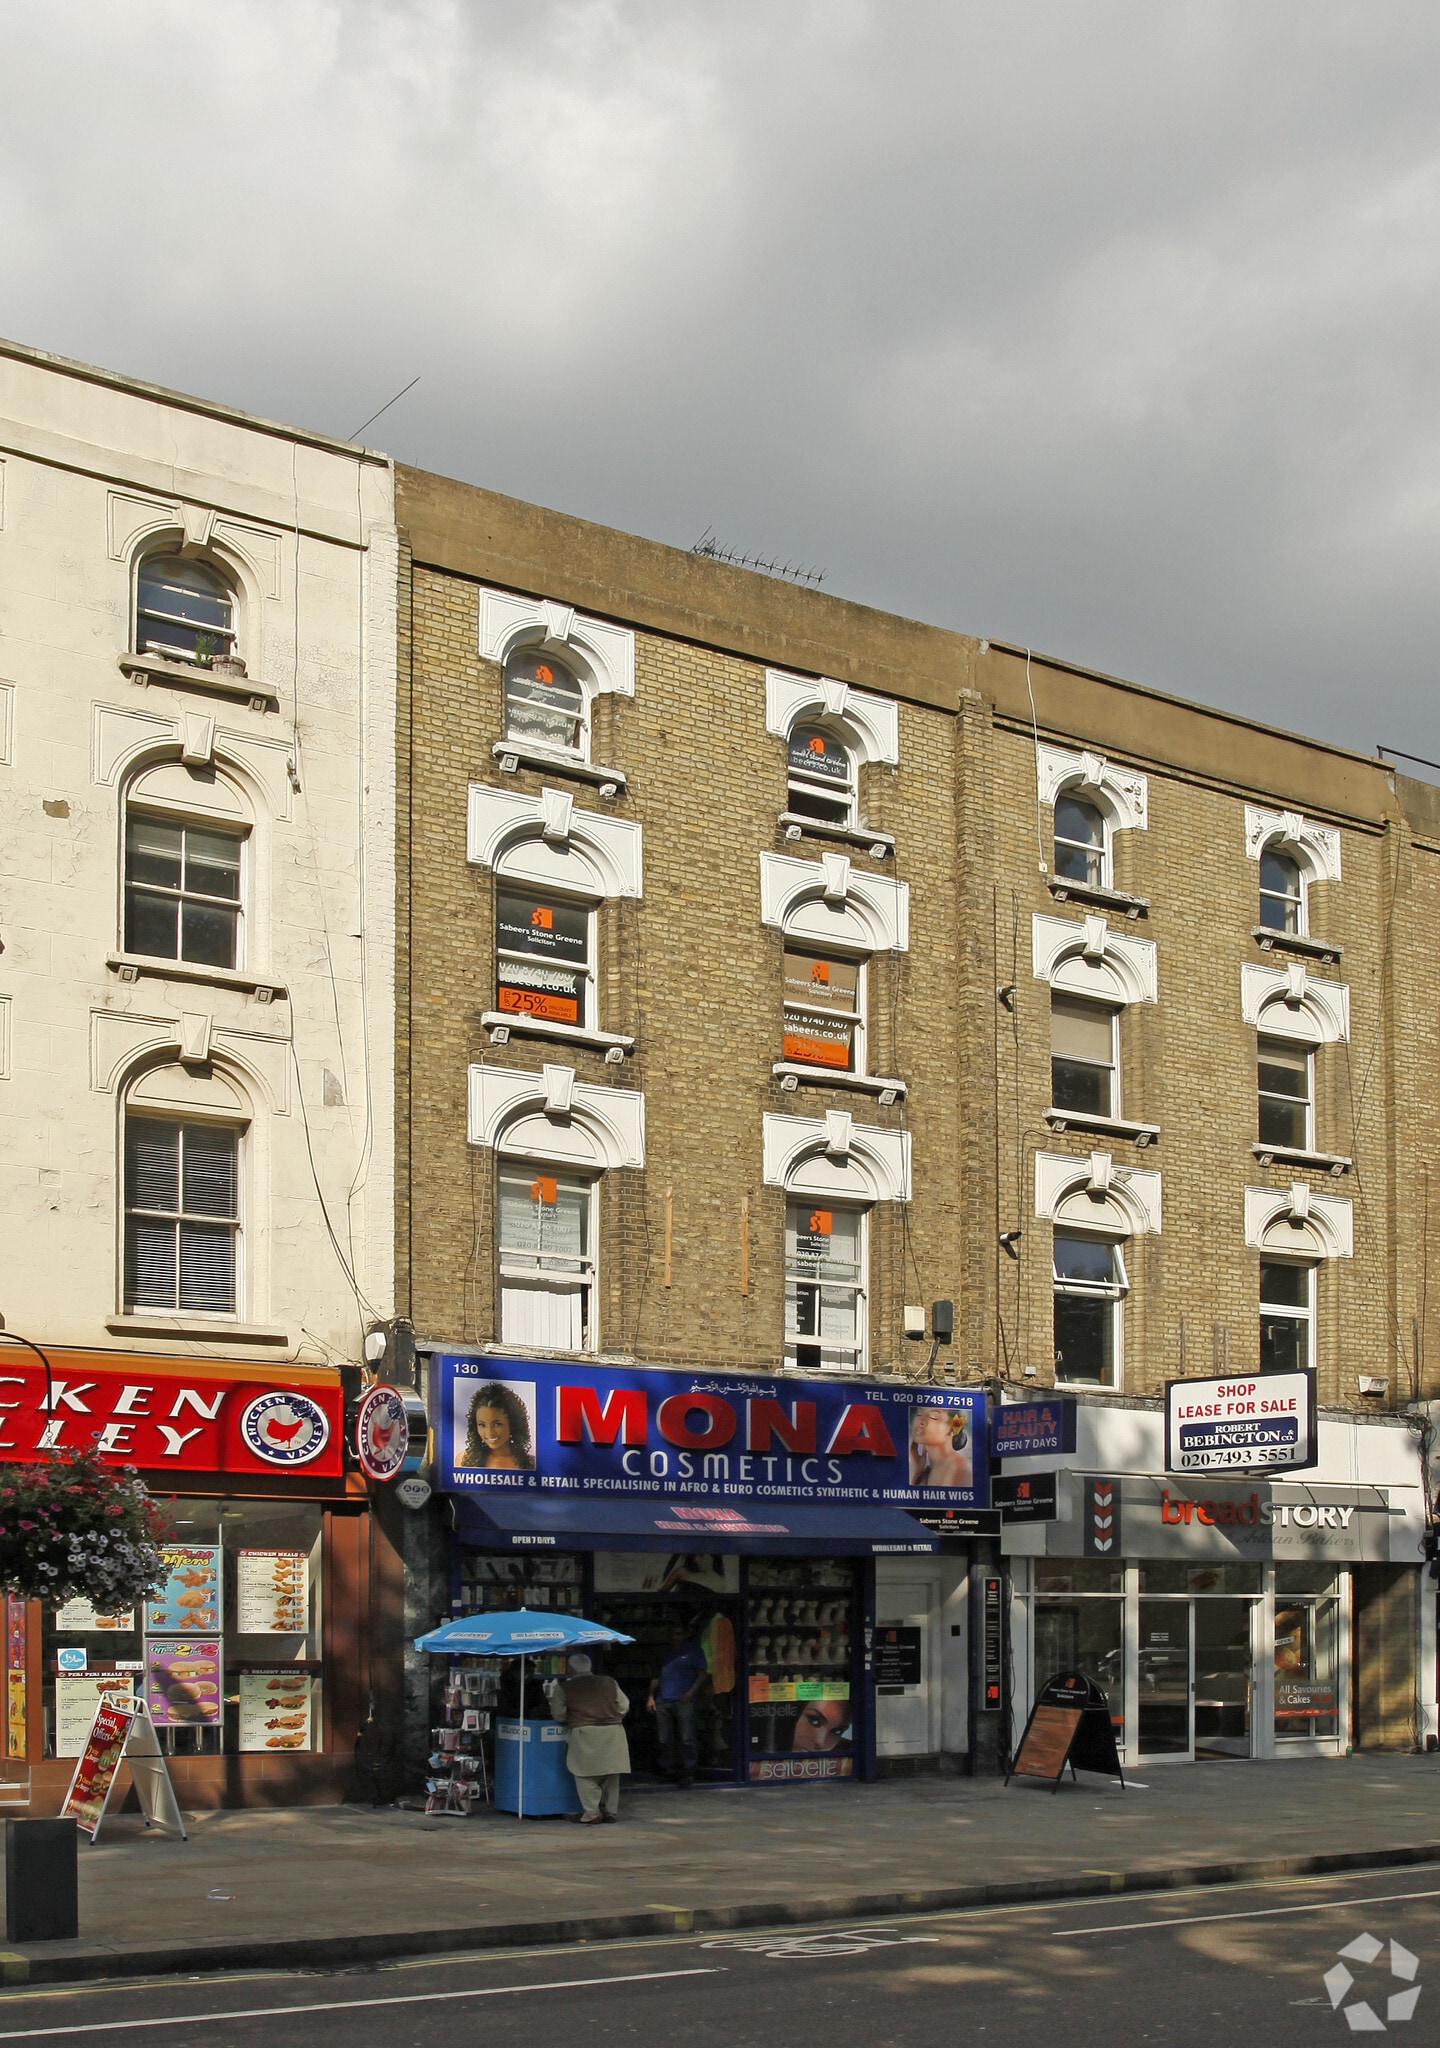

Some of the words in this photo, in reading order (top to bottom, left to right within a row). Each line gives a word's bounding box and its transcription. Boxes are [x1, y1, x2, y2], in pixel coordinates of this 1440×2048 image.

[499, 922, 530, 935] Sabeers
[531, 929, 553, 940] Stone
[555, 933, 583, 945] Greene
[527, 935, 556, 946] Solicitors
[784, 976, 811, 987] Sabeers
[811, 981, 831, 991] Stone
[831, 985, 856, 996] Greene
[511, 991, 548, 1014] 25%
[783, 1023, 849, 1041] sabeers.co.uk
[454, 1363, 478, 1374] 130
[865, 1391, 889, 1401] TEL.
[893, 1393, 914, 1403] 020
[916, 1394, 944, 1405] 8749
[947, 1396, 974, 1406] 7518
[1217, 1383, 1256, 1398] SHOP
[1003, 1408, 1037, 1425] HAIR
[1041, 1407, 1052, 1420] &
[1178, 1404, 1222, 1419] LEASE
[1227, 1402, 1256, 1416] FOR
[1260, 1398, 1297, 1413] SALE
[248, 1396, 287, 1447] CHICKEN
[361, 1393, 386, 1456] CHICKEN
[556, 1385, 898, 1457] MONA
[1215, 1422, 1261, 1433] ROBERT
[998, 1421, 1057, 1439] BEAUTY
[286, 1421, 322, 1459] VALLEY
[996, 1440, 1022, 1452] OPEN
[1025, 1439, 1031, 1449] 7
[1032, 1437, 1058, 1449] DAYS
[1183, 1430, 1281, 1448] BEBINGTON
[382, 1424, 407, 1473] VALLEY
[1181, 1451, 1252, 1468] 020-7493
[1257, 1447, 1296, 1463] 5551
[622, 1450, 843, 1485] COSMETICS
[403, 1485, 429, 1494] AFS
[453, 1473, 524, 1486] WHOLESALE
[528, 1477, 537, 1487] &
[541, 1477, 580, 1489] RETAIL
[583, 1478, 660, 1491] SPECIALISING
[664, 1481, 676, 1492] IN
[680, 1482, 708, 1493] AFRO
[711, 1483, 720, 1494] &
[724, 1484, 753, 1495] EURO
[756, 1485, 814, 1497] COSMETICS
[817, 1487, 869, 1499] SYNTHETIC
[872, 1488, 880, 1499] &
[883, 1489, 920, 1500] HUMAN
[923, 1490, 946, 1501] HAIR
[948, 1490, 974, 1501] WIGS
[1016, 1499, 1033, 1507] Stone
[1033, 1497, 1054, 1505] Greene
[670, 1506, 748, 1521] MONA
[512, 1536, 531, 1544] OPEN
[531, 1536, 537, 1544] 7
[537, 1536, 556, 1545] DAYS
[1296, 1530, 1355, 1546] Bakers
[872, 1544, 907, 1552] WHOLESALE
[913, 1544, 933, 1552] RETAIL
[158, 1554, 209, 1568] Offers
[174, 1643, 191, 1657] 2
[1279, 1685, 1290, 1694] All
[1292, 1684, 1332, 1694] Savouries
[1279, 1696, 1286, 1704] &
[1287, 1695, 1311, 1704] Cakes
[749, 1704, 798, 1718] seibella
[97, 1713, 117, 1727] Special
[93, 1727, 111, 1742] Offers
[109, 1725, 118, 1741] 2
[84, 1744, 93, 1760] 2
[763, 1757, 837, 1779] seibella
[75, 1773, 83, 1789] 2
[66, 1799, 74, 1815] 2
